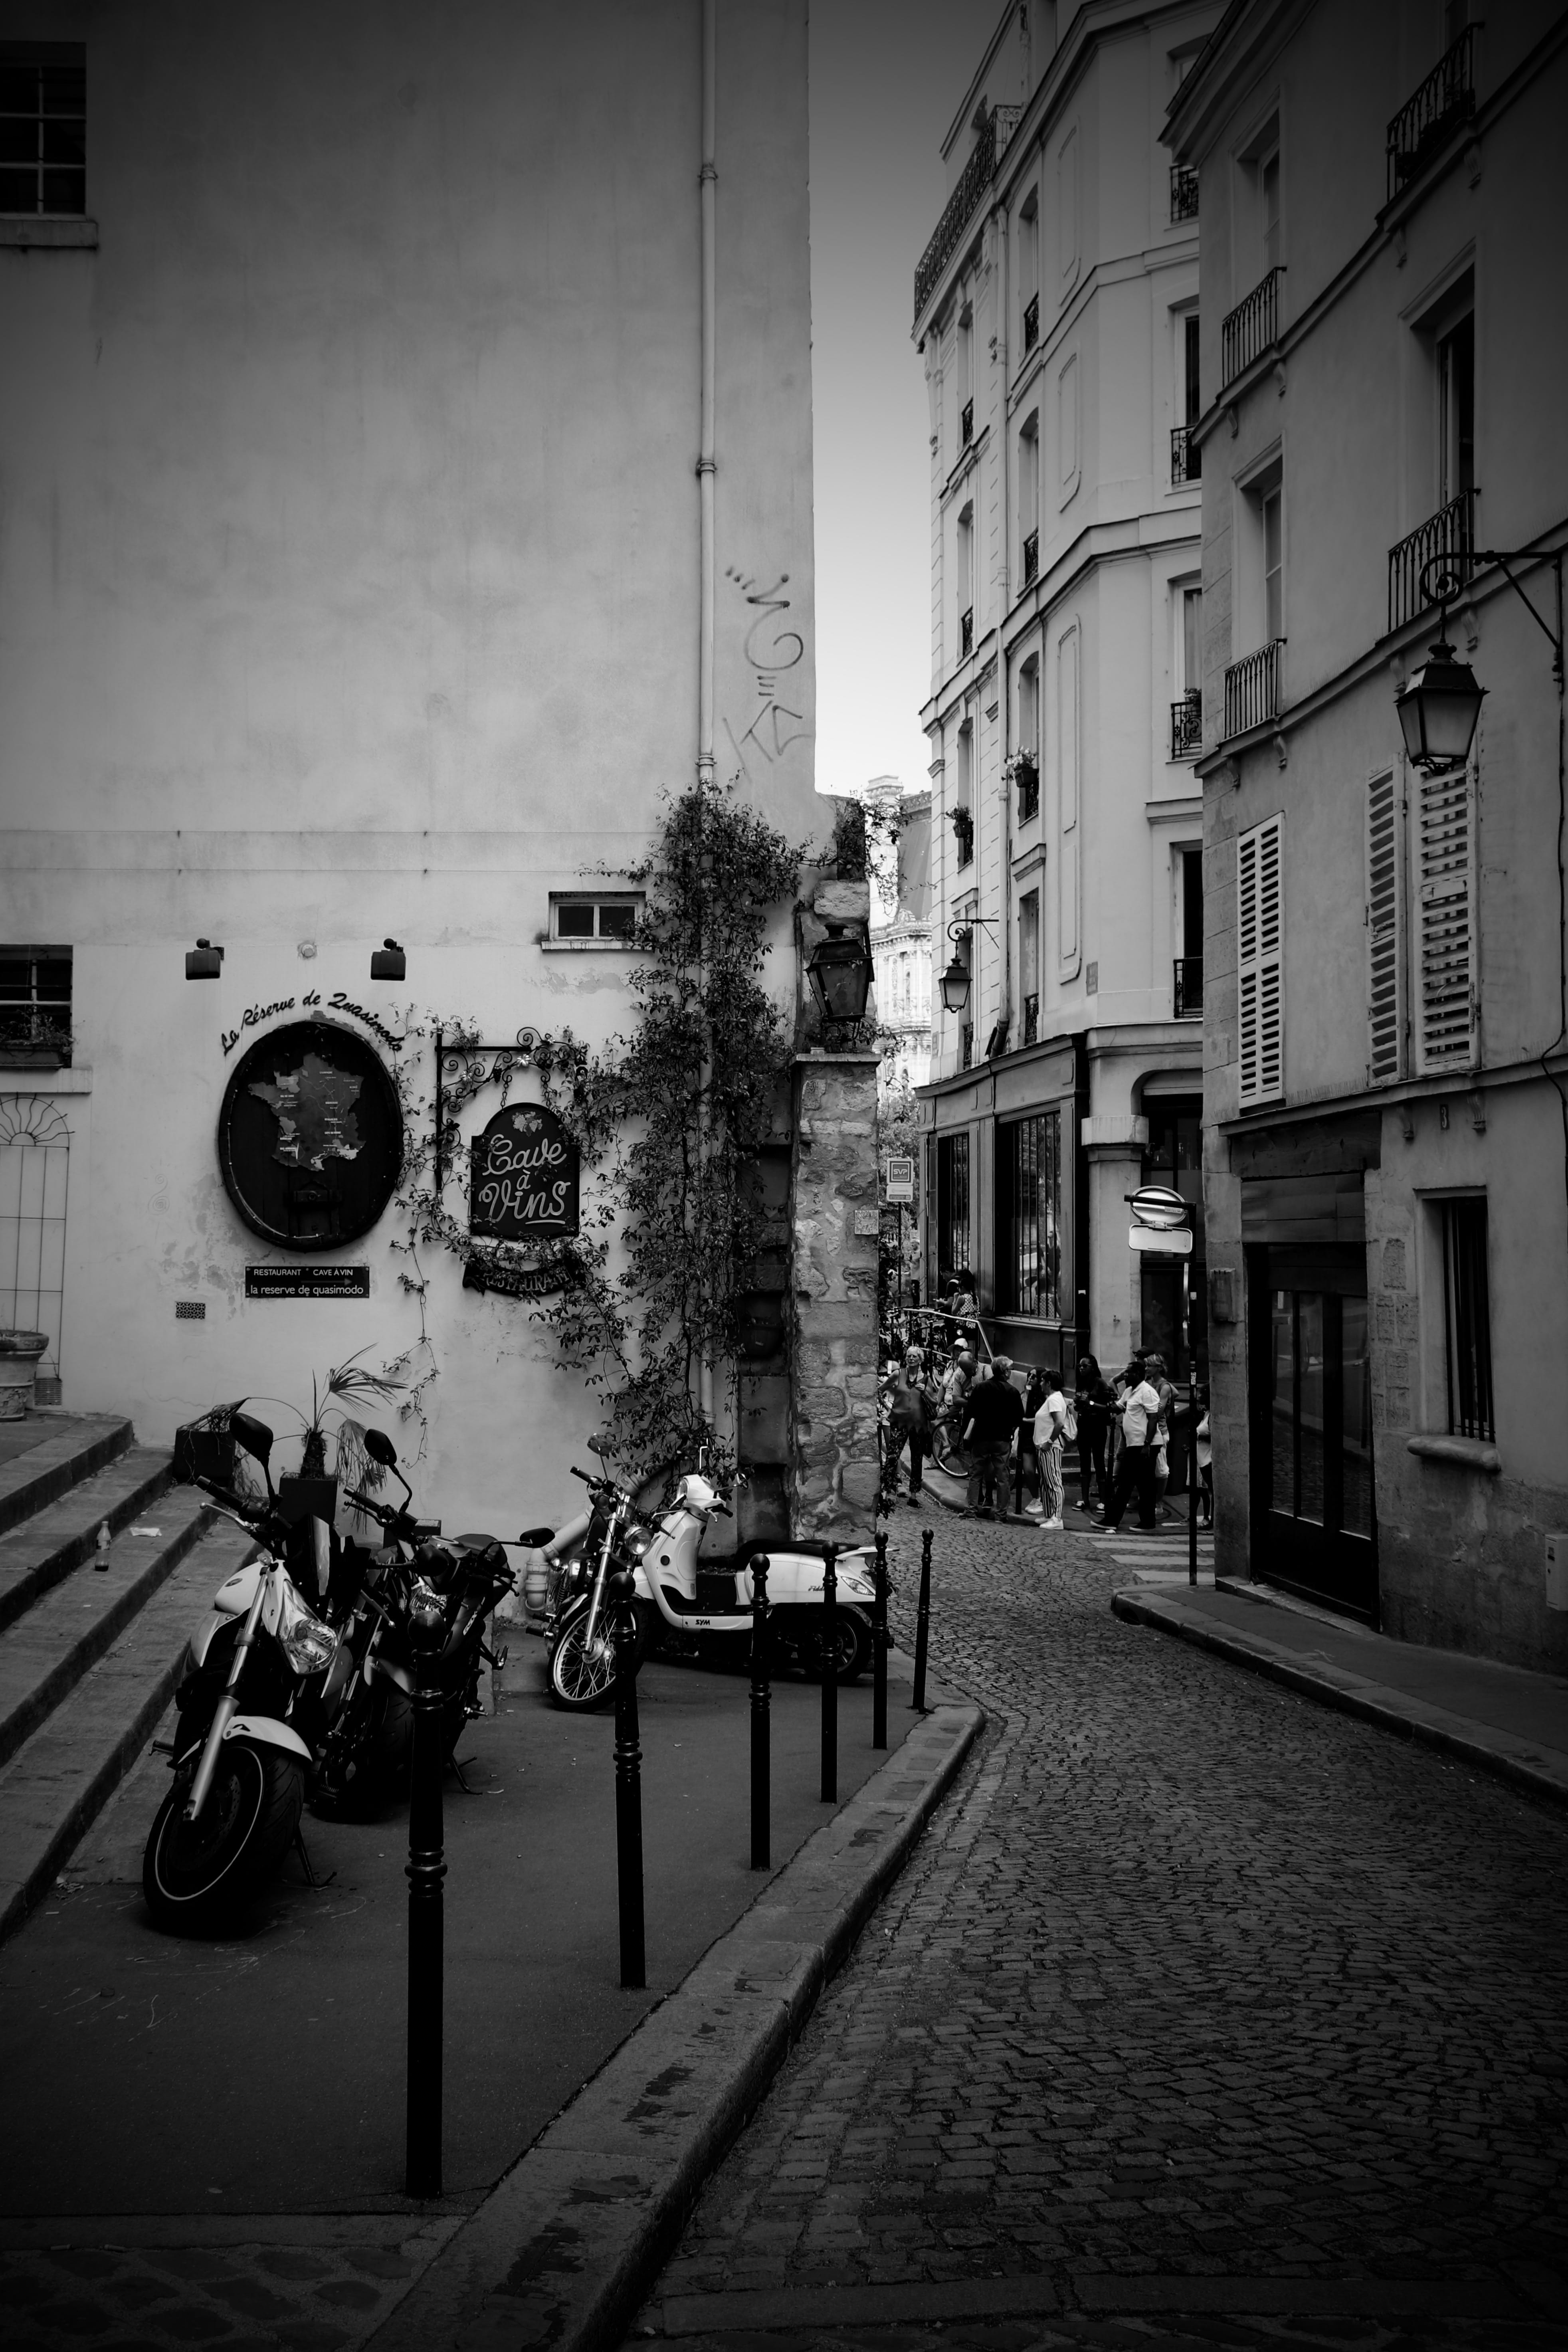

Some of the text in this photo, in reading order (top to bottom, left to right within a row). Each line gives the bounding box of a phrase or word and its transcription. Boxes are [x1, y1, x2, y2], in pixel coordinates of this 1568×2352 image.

[221, 989, 405, 1056] La Réserve de Quasimodo
[1441, 1106, 1447, 1128] 3
[482, 1134, 567, 1175] Cave
[517, 1169, 531, 1190] à
[479, 1179, 571, 1222] Vins
[251, 1285, 258, 1294] la
[298, 1285, 310, 1294] de
[313, 1285, 364, 1296] quasimodo
